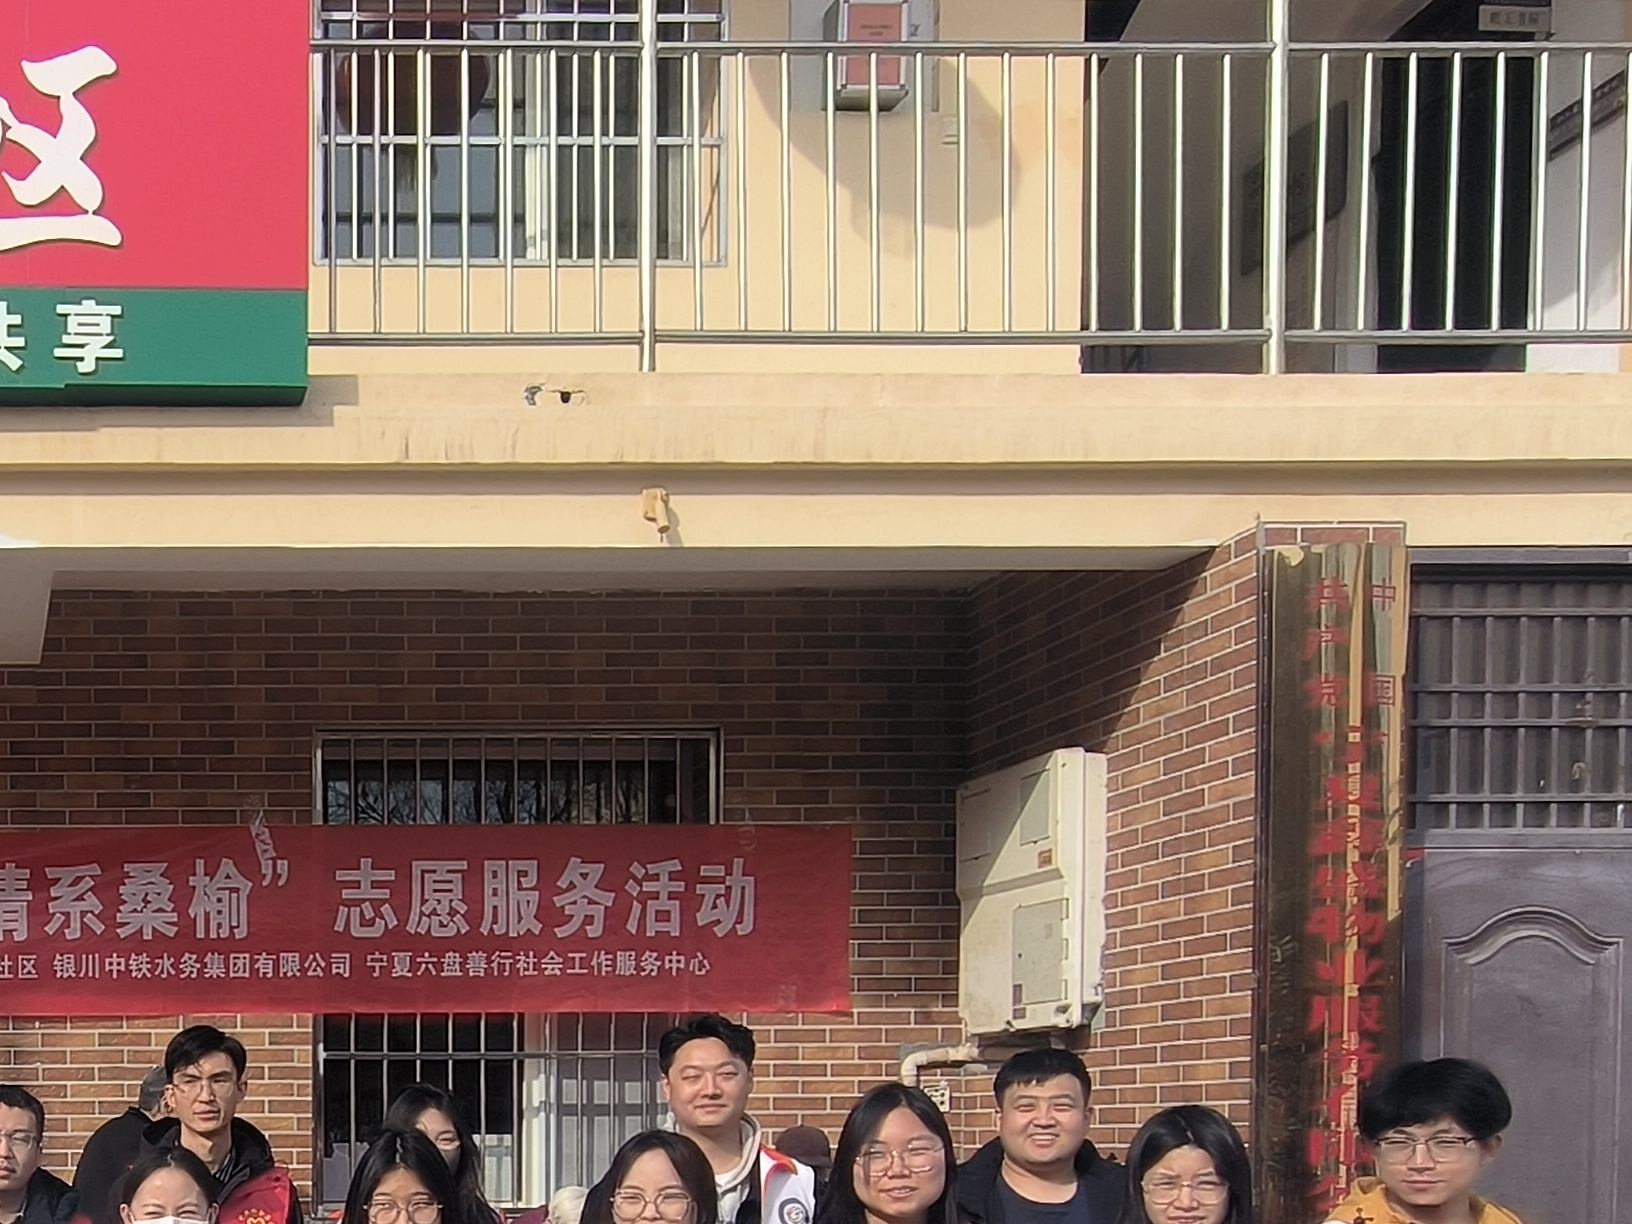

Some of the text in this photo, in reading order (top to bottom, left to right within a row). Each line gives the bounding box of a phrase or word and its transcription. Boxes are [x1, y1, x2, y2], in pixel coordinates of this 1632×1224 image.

[52, 951, 352, 980] 银川中铁水务集团有限公司
[365, 949, 712, 978] 宁夏六盘善行社会工作服务中心
